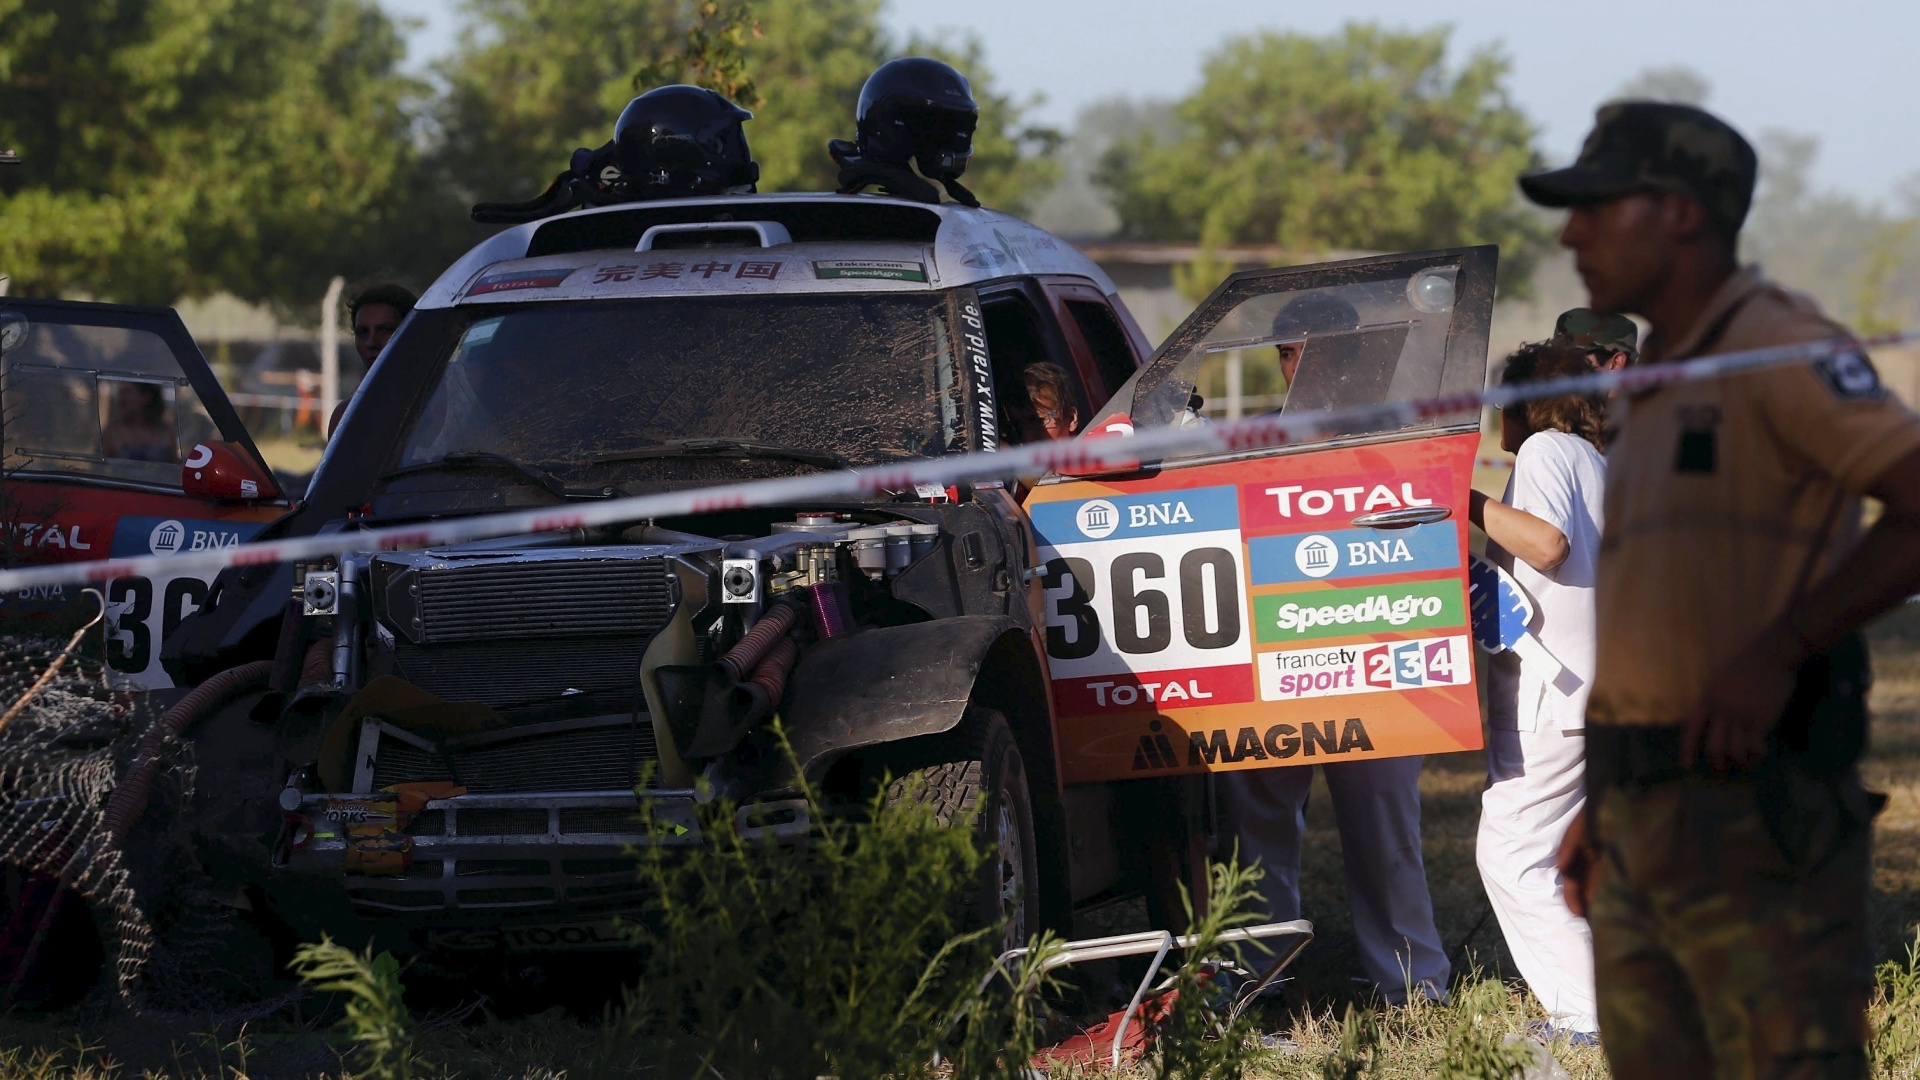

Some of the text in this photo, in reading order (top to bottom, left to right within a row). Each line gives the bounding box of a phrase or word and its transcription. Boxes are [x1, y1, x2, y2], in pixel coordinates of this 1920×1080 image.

[593, 261, 784, 284] 完美中国
[835, 261, 904, 269] dakar.com
[839, 269, 904, 278] SpeedAgro
[491, 280, 538, 291] TOTAL
[1265, 482, 1433, 518] TOTAL
[1128, 500, 1194, 529] BNA
[188, 530, 241, 552] BNA
[1347, 538, 1414, 567] BNA
[1042, 547, 1241, 660] 360
[1276, 594, 1443, 634] SpeedAgro
[1276, 648, 1356, 670] francetv
[1086, 680, 1213, 707] TOTAL
[1279, 664, 1356, 697] sport
[1187, 717, 1375, 766] MAGNA
